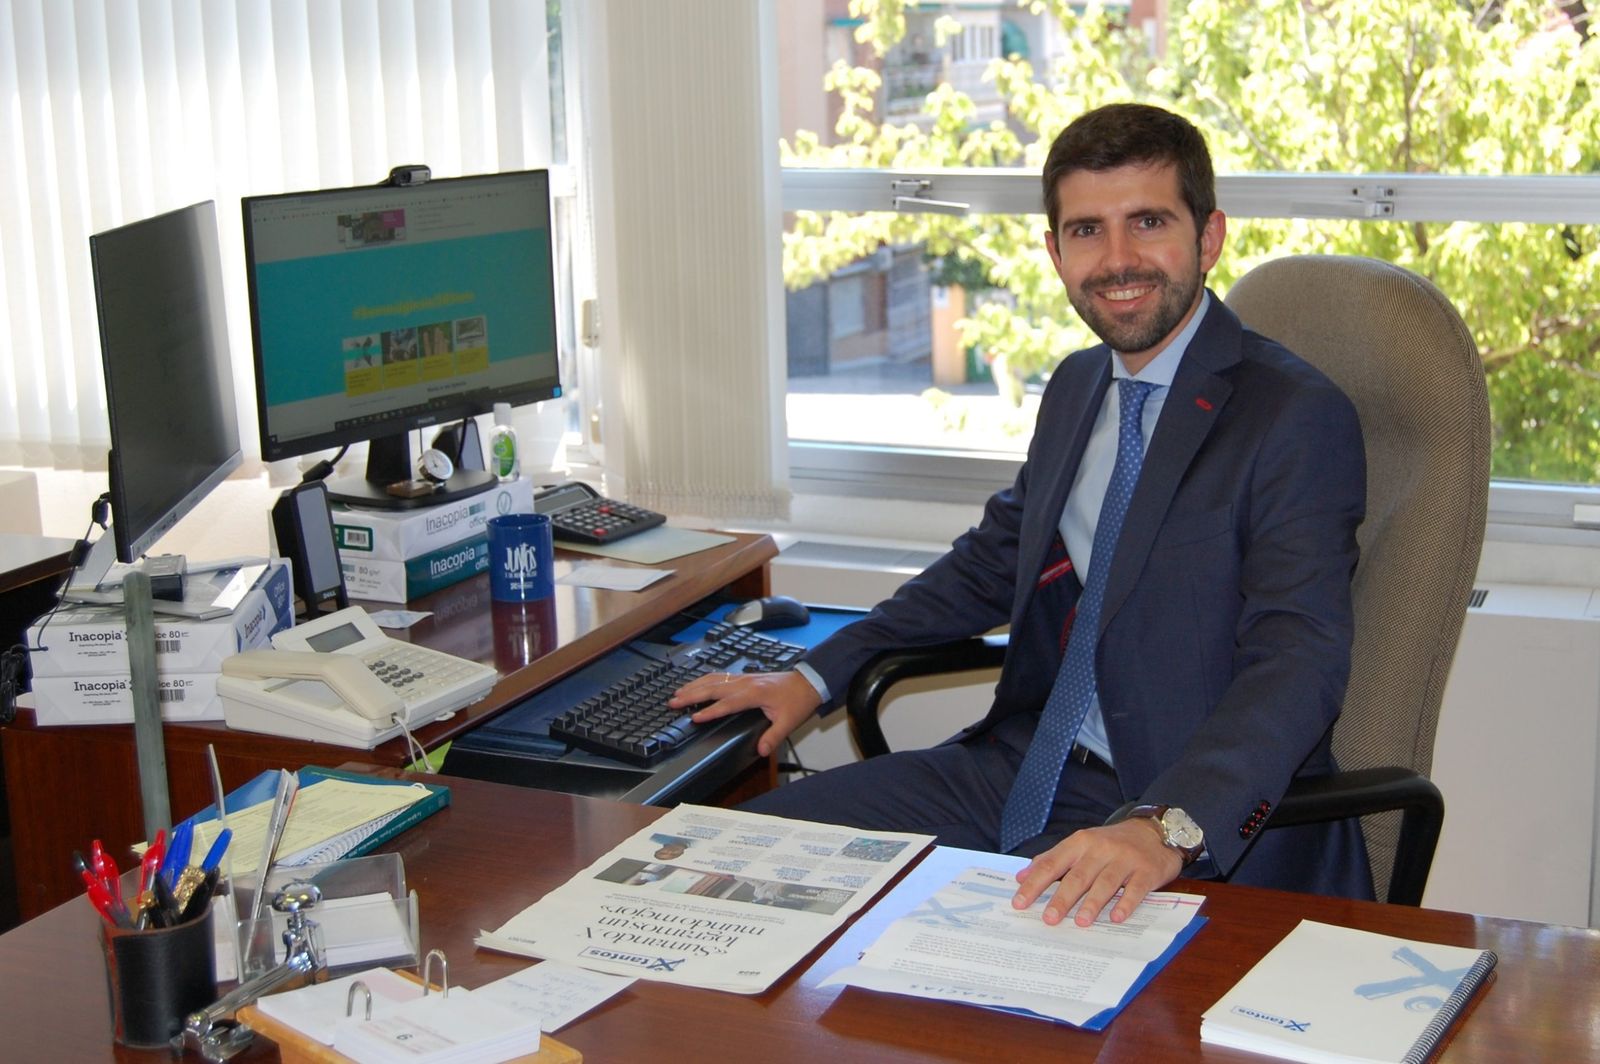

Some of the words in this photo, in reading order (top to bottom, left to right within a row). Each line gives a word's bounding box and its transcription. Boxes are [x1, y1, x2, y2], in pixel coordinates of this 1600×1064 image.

[425, 505, 469, 532] Inacopia
[430, 545, 475, 575] Inacopia
[344, 573, 355, 582] ice
[69, 630, 123, 644] Inacopia
[169, 630, 180, 639] 80
[74, 680, 126, 693] Inacopia
[159, 680, 171, 688] ice
[173, 679, 185, 688] 80
[598, 916, 630, 929] un
[680, 916, 765, 936] mundo
[635, 923, 739, 948] logramos
